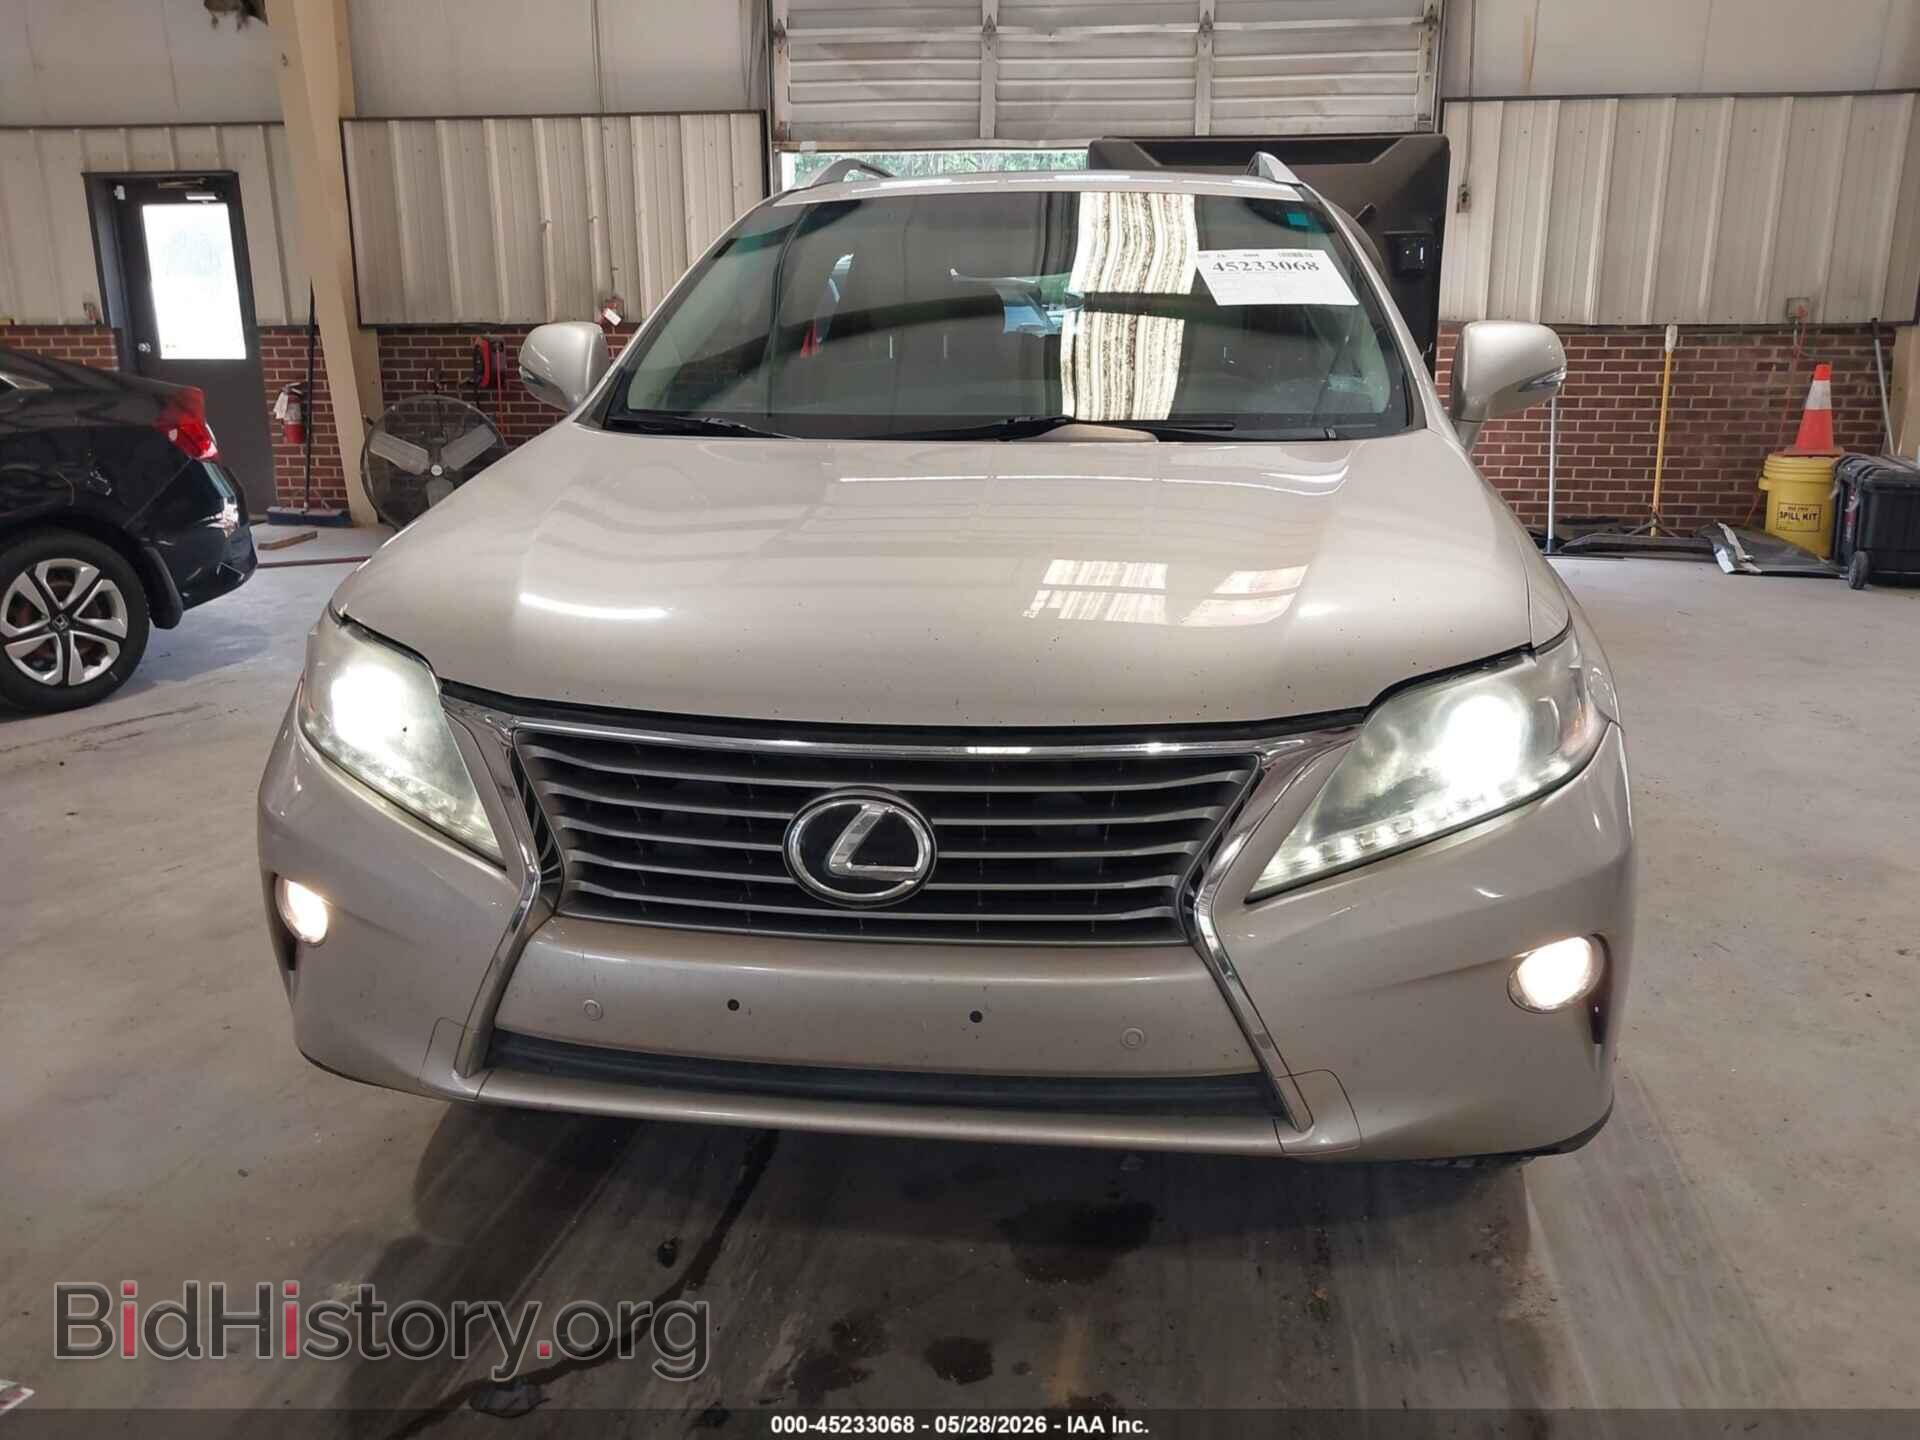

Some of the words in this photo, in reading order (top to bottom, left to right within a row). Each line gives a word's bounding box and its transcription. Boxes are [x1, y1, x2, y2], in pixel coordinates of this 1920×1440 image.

[1212, 260, 1320, 272] 45233068
[1779, 511, 1800, 521] SPILL
[1801, 512, 1817, 521] KIT
